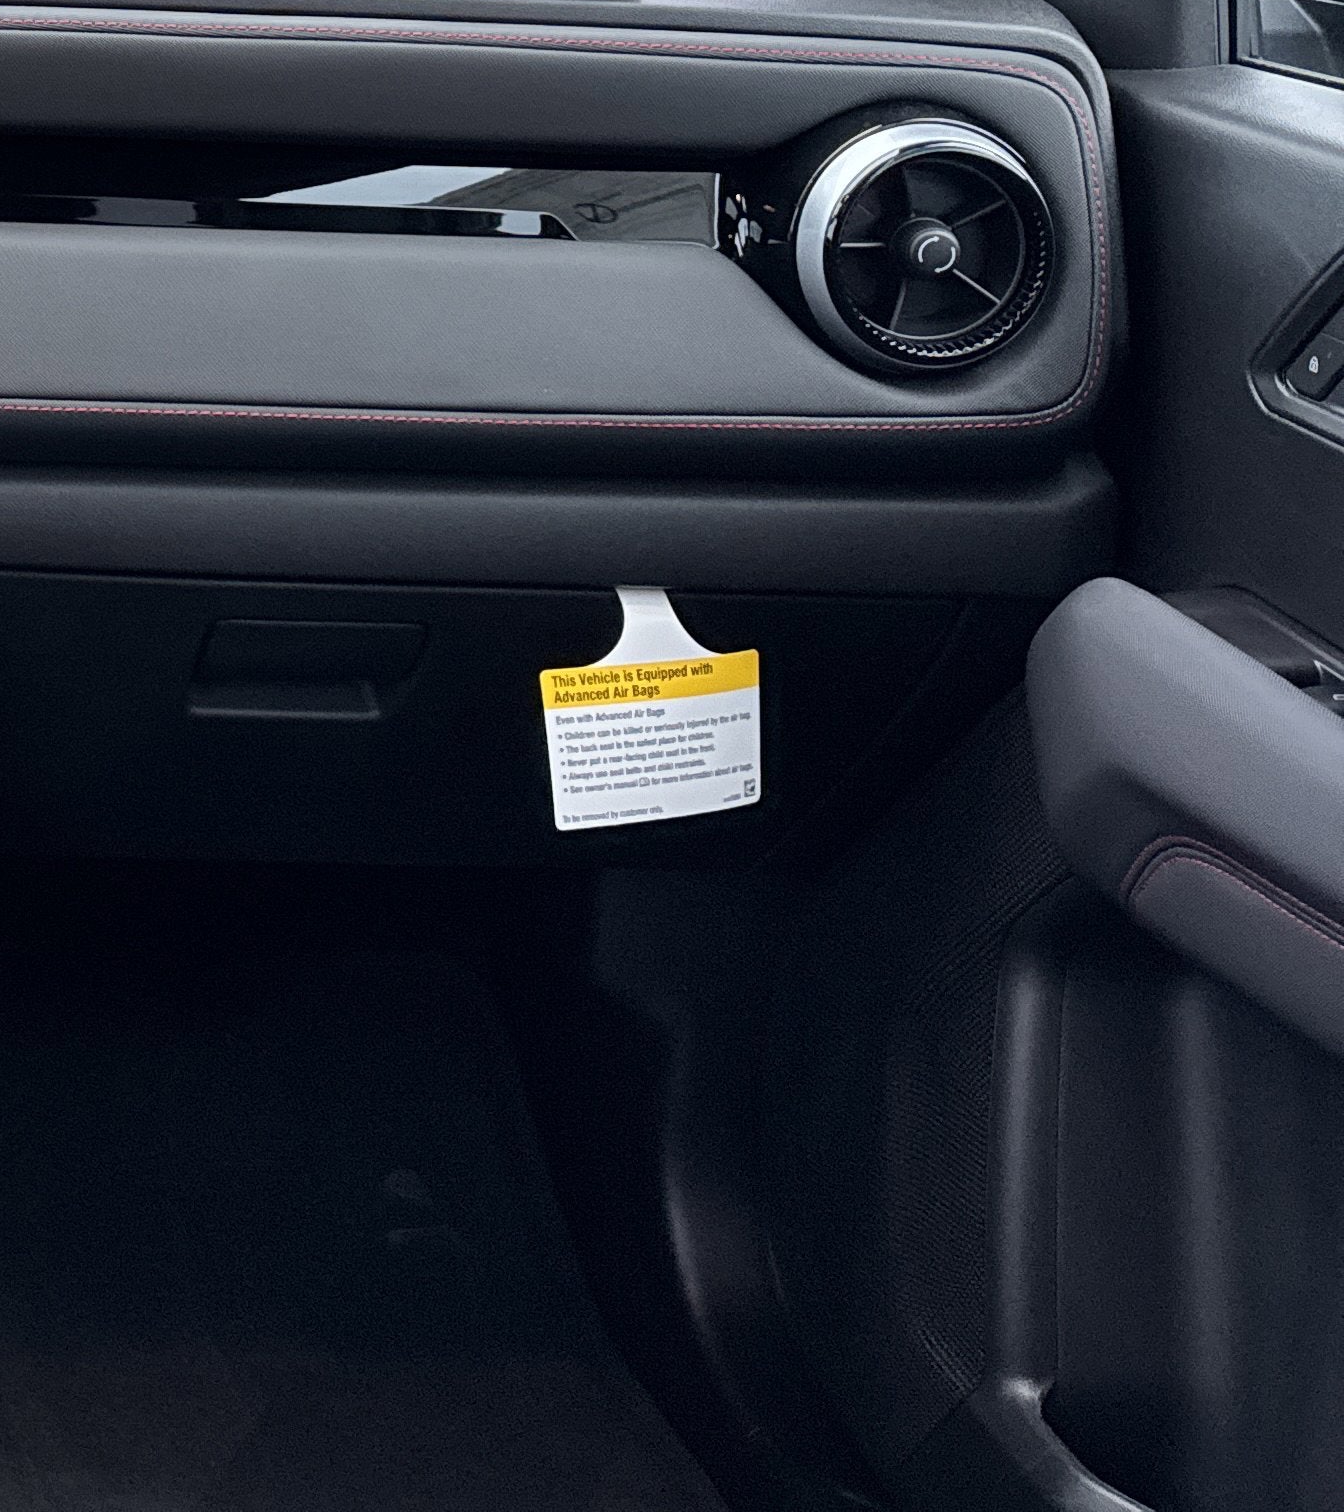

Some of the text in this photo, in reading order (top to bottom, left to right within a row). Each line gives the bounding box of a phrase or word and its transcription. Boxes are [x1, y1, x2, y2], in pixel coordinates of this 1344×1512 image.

[551, 662, 714, 688] This Vehicle is Equipped with
[554, 684, 661, 704] Advanced Air Bags
[555, 707, 666, 726] Even with Advanced Air Bags
[564, 731, 596, 741] Children
[612, 728, 621, 737] be
[623, 726, 644, 735] killed
[686, 717, 709, 729] injured
[710, 717, 718, 727] by
[562, 814, 571, 824] To
[572, 814, 581, 823] be
[610, 810, 619, 821] by
